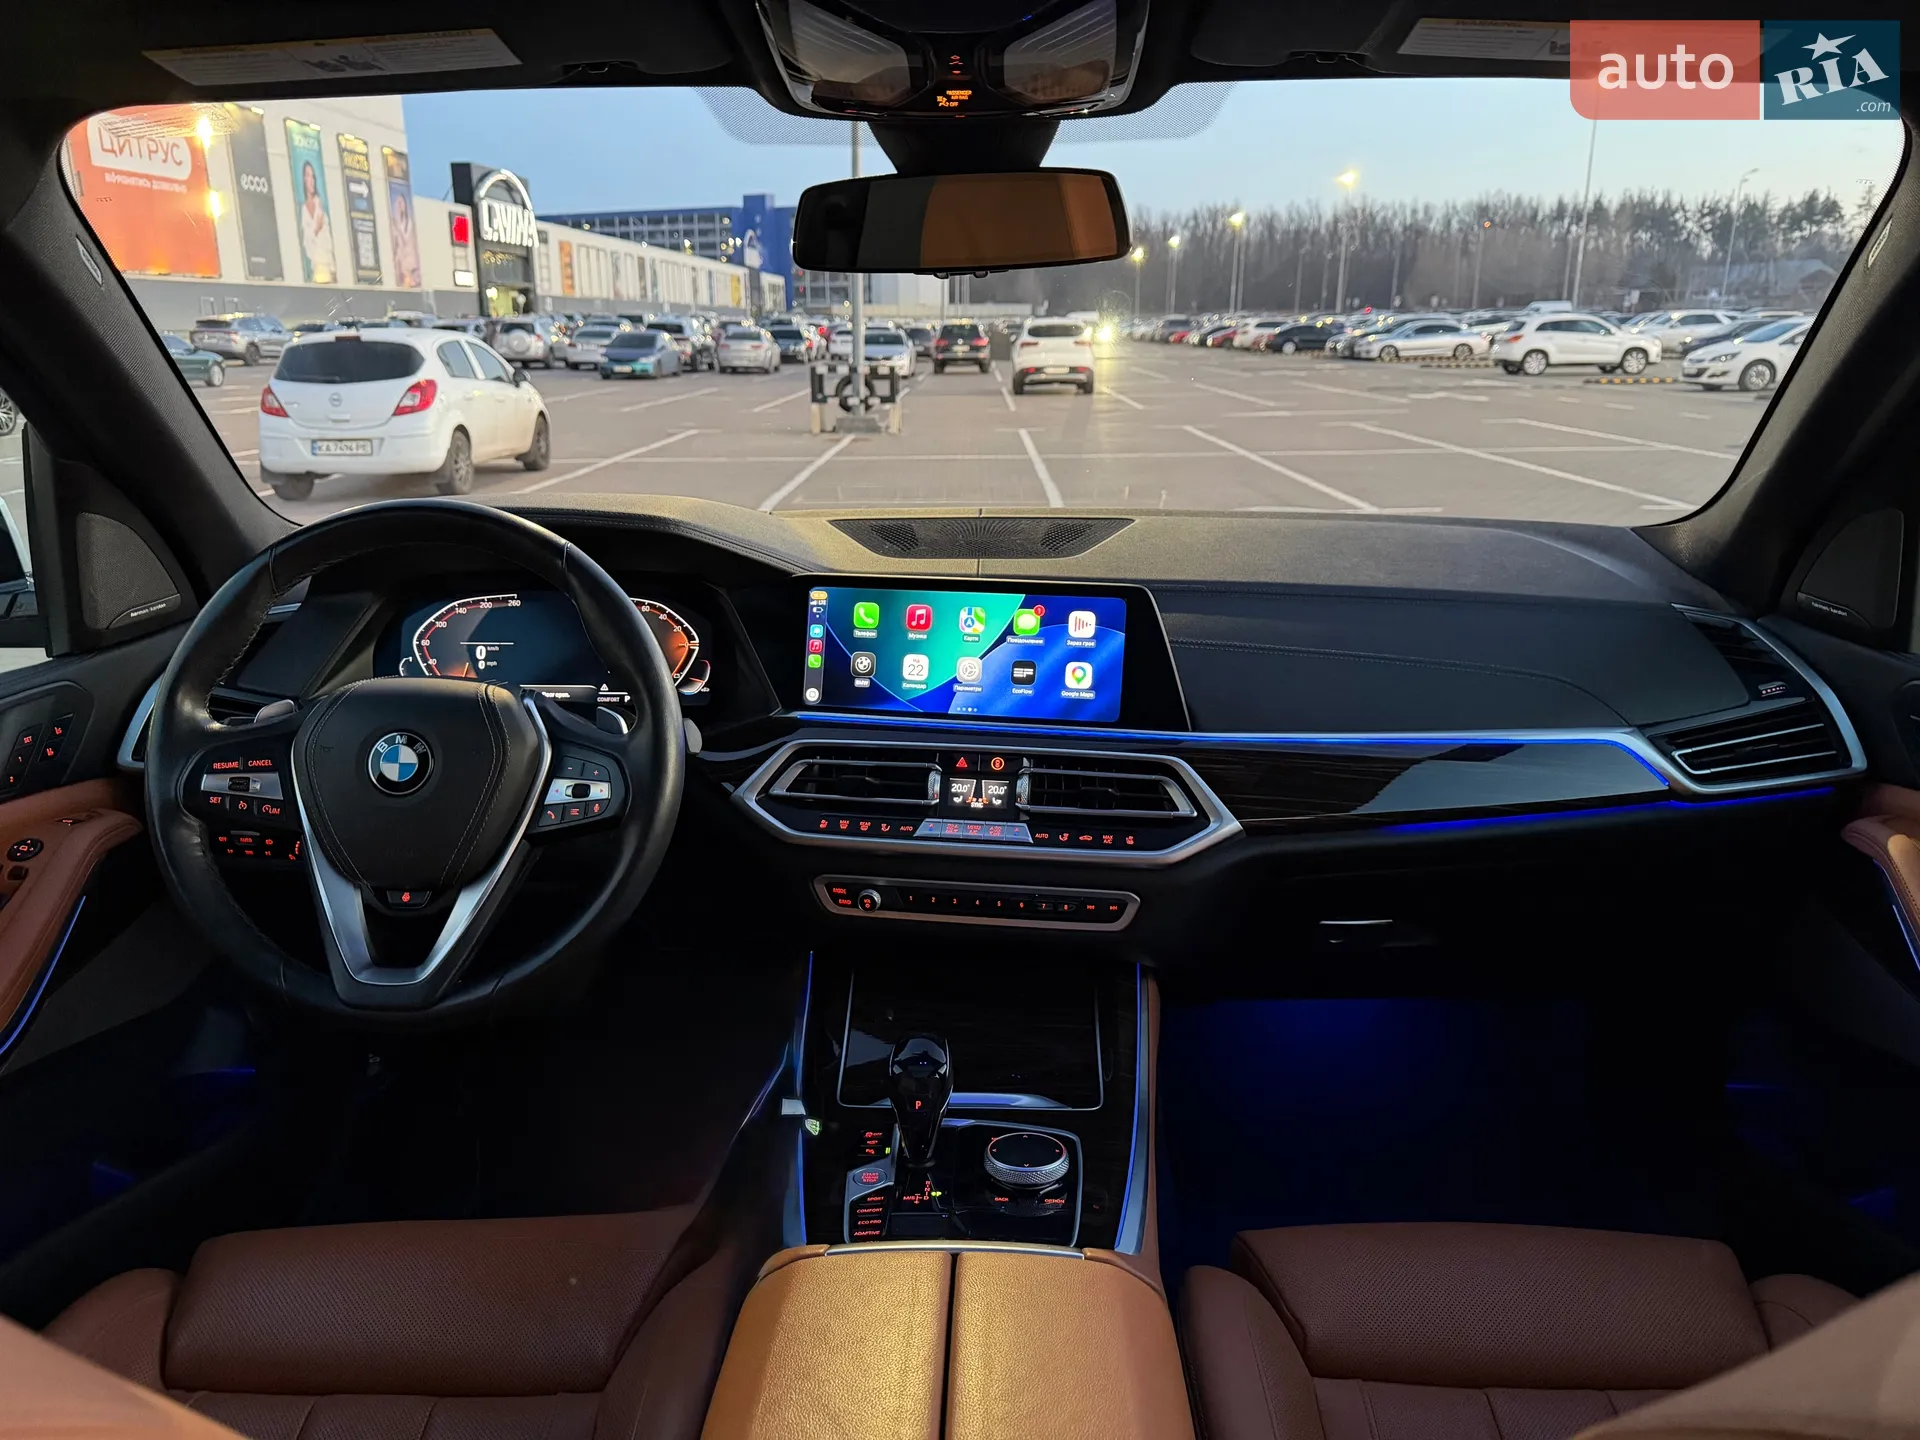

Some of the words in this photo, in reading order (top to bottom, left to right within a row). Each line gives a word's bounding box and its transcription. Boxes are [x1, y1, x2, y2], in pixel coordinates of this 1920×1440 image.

[97, 126, 184, 167] ЦИТРУС
[508, 599, 522, 608] 260
[455, 607, 468, 615] 140
[658, 613, 668, 621] 40
[435, 620, 448, 628] 100
[673, 625, 683, 633] 20
[421, 639, 431, 647] 60
[475, 645, 487, 661] 0
[428, 657, 438, 666] 40
[478, 660, 486, 670] 0
[487, 660, 499, 668] mph
[907, 663, 924, 677] 22
[1061, 689, 1079, 698] Google
[1079, 690, 1094, 699] Maps
[624, 695, 631, 703] P
[376, 734, 427, 755] BMW
[213, 761, 239, 770] RESUME
[247, 759, 273, 767] CANCEL
[209, 796, 222, 804] SET
[915, 1100, 922, 1110] P
